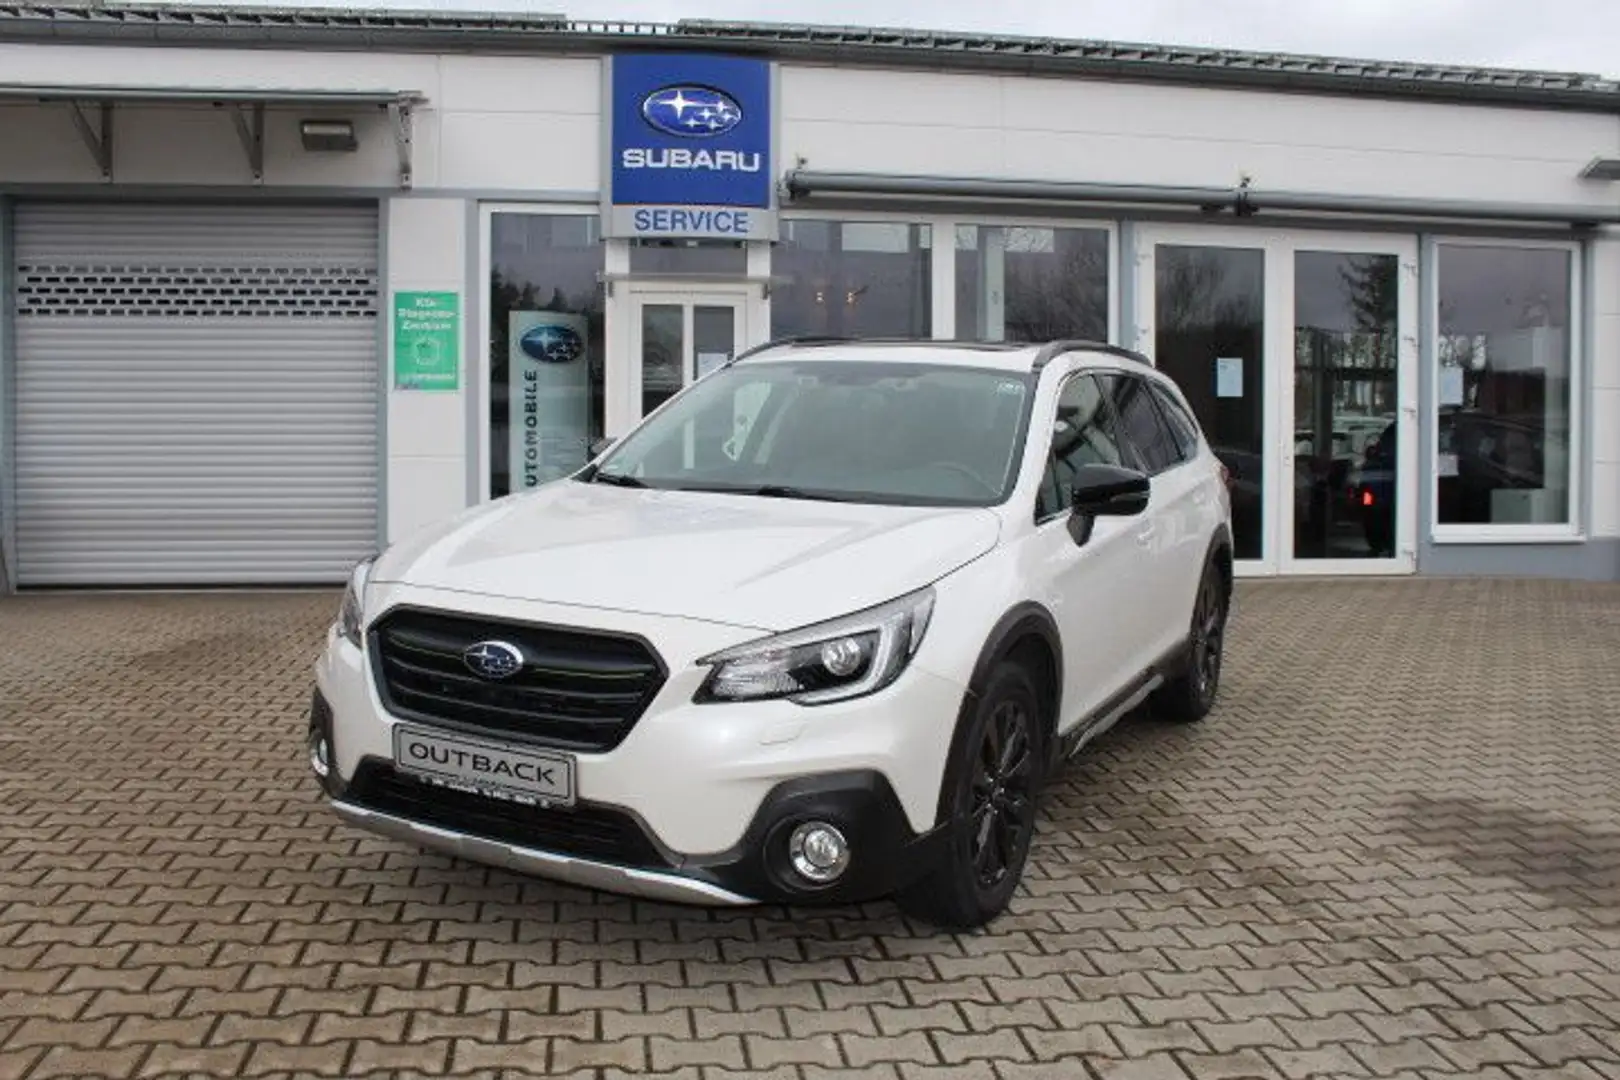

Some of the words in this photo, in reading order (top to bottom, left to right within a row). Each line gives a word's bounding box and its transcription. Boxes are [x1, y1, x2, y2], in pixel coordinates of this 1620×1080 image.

[622, 148, 761, 173] SUBARU
[634, 208, 749, 234] SERVICE
[523, 369, 538, 488] UTOMOBILE
[409, 742, 555, 785] OUTBACK
